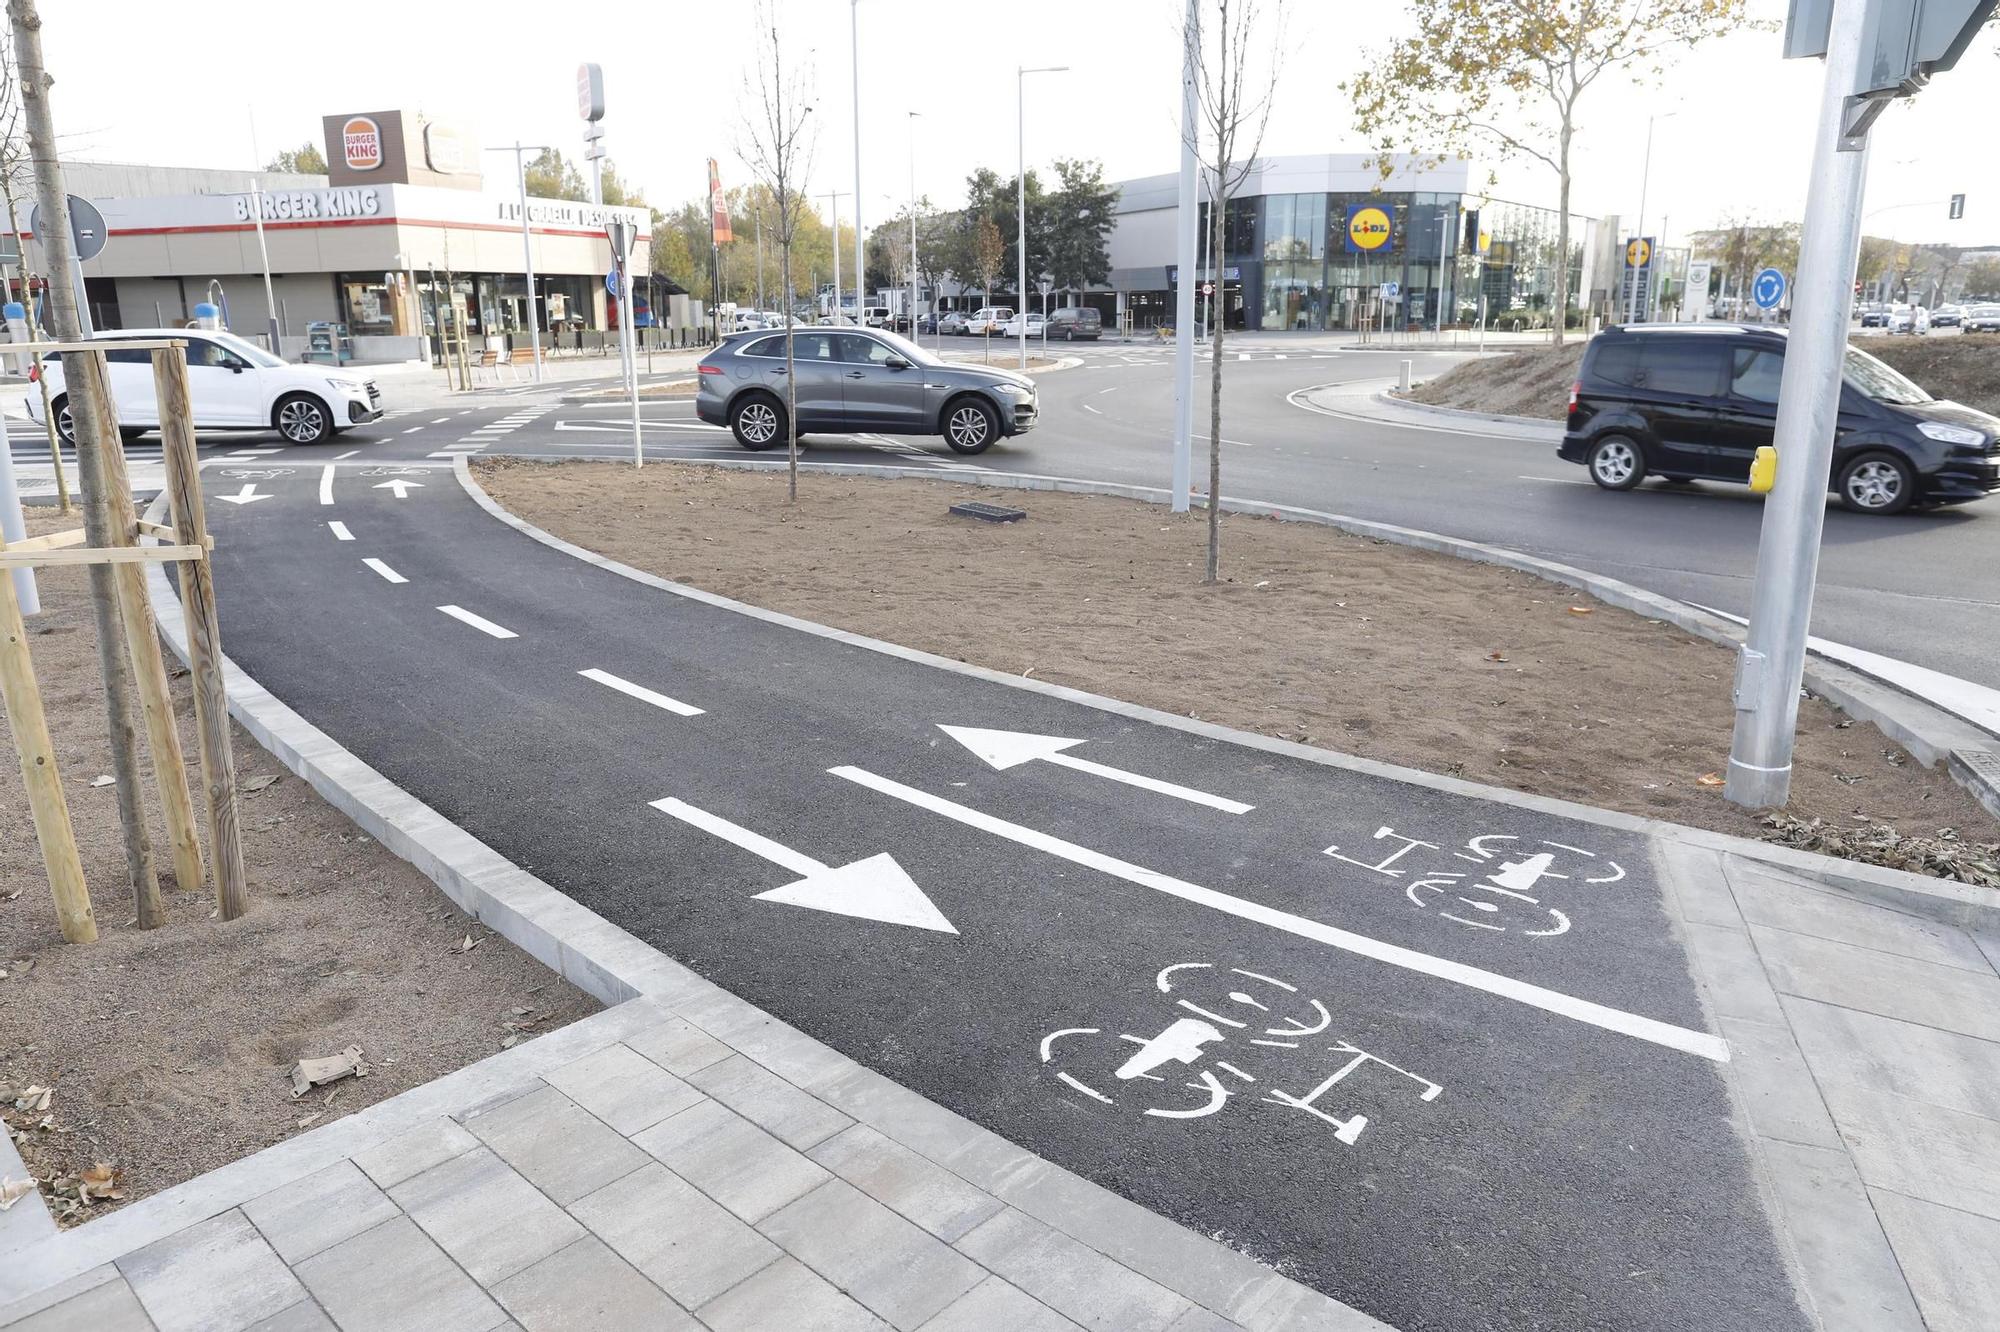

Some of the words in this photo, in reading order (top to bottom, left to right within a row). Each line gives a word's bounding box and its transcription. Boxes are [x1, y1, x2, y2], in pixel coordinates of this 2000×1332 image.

[345, 134, 376, 145] BURGER
[347, 144, 377, 158] KING
[323, 189, 379, 217] KING
